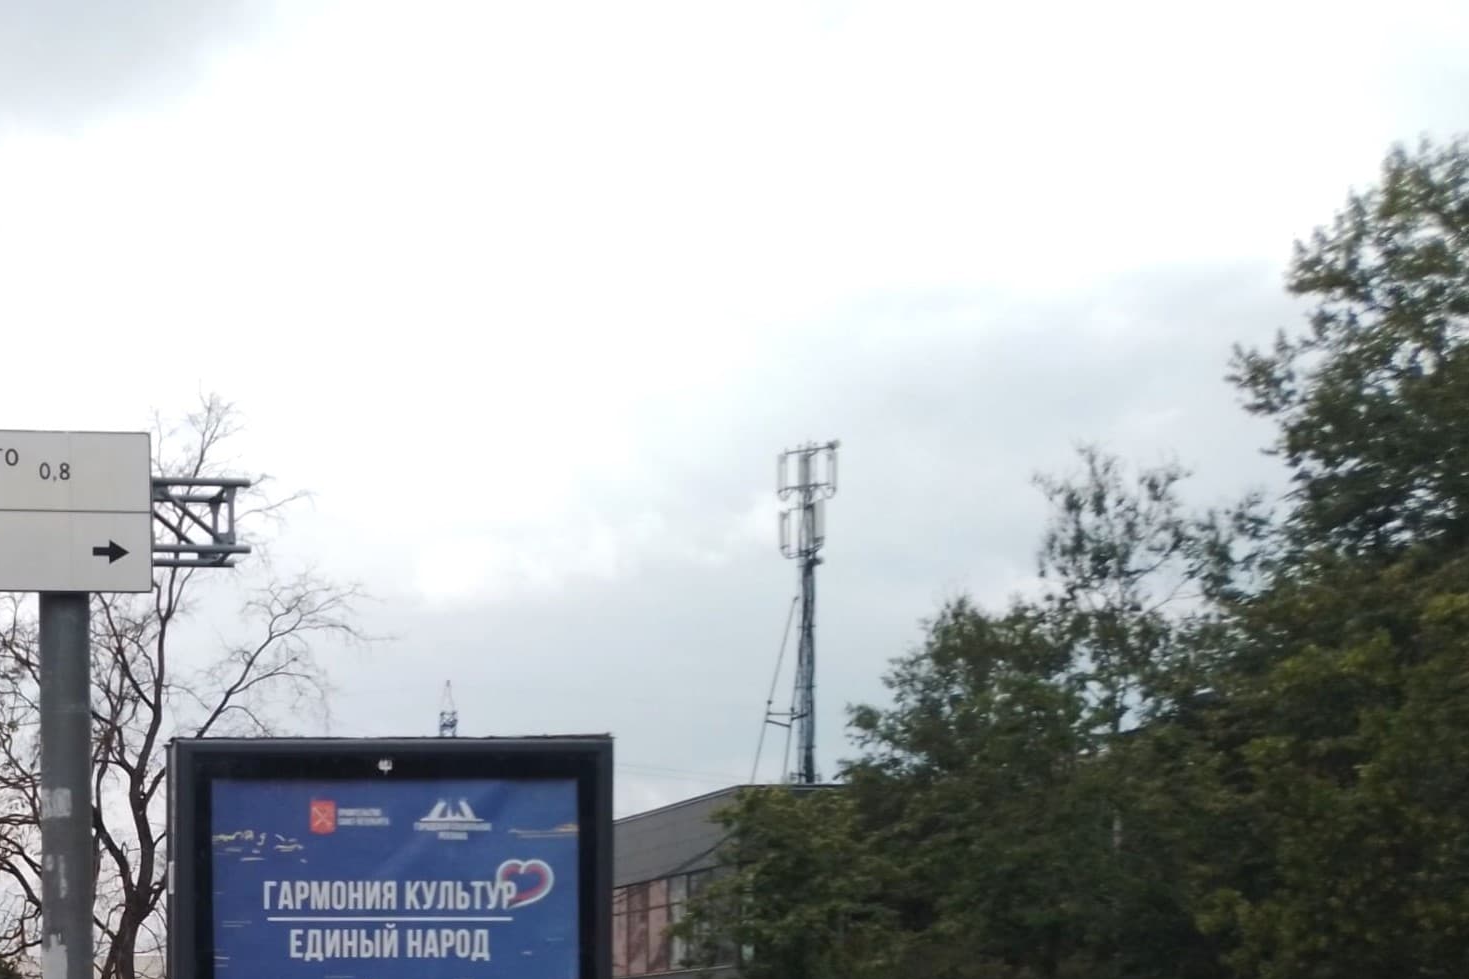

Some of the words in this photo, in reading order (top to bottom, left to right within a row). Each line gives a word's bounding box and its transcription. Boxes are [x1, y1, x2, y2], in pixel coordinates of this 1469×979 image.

[38, 462, 72, 482] 0,8
[263, 880, 398, 912] ГАРМОНИЯ
[405, 880, 518, 911] КУЛЬТУР
[289, 922, 399, 962] ЕДИНЫЙ
[406, 928, 492, 962] НАРОД
